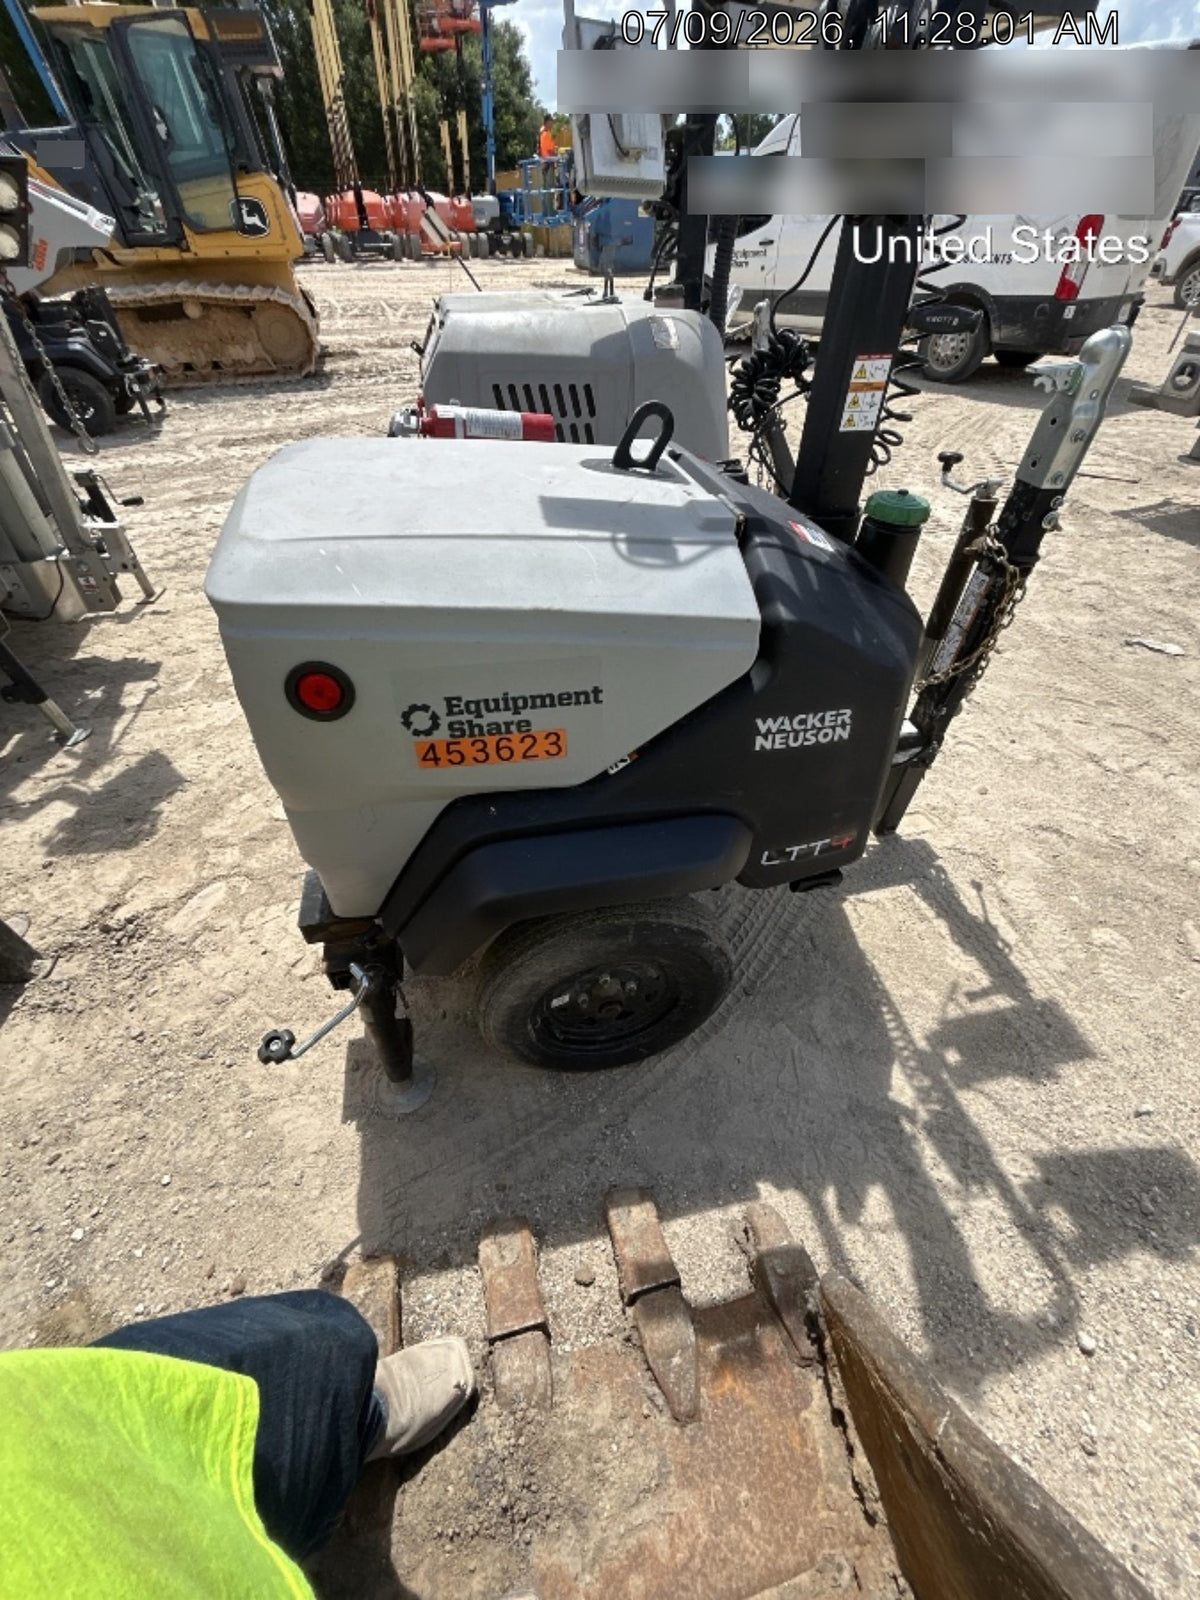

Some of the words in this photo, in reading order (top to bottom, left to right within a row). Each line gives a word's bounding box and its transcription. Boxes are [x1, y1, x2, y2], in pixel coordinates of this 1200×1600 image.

[443, 685, 604, 718] Equipment
[446, 718, 533, 739] Share
[754, 708, 853, 734] WACKER
[420, 731, 564, 767] 453623
[754, 725, 851, 751] NEUSON
